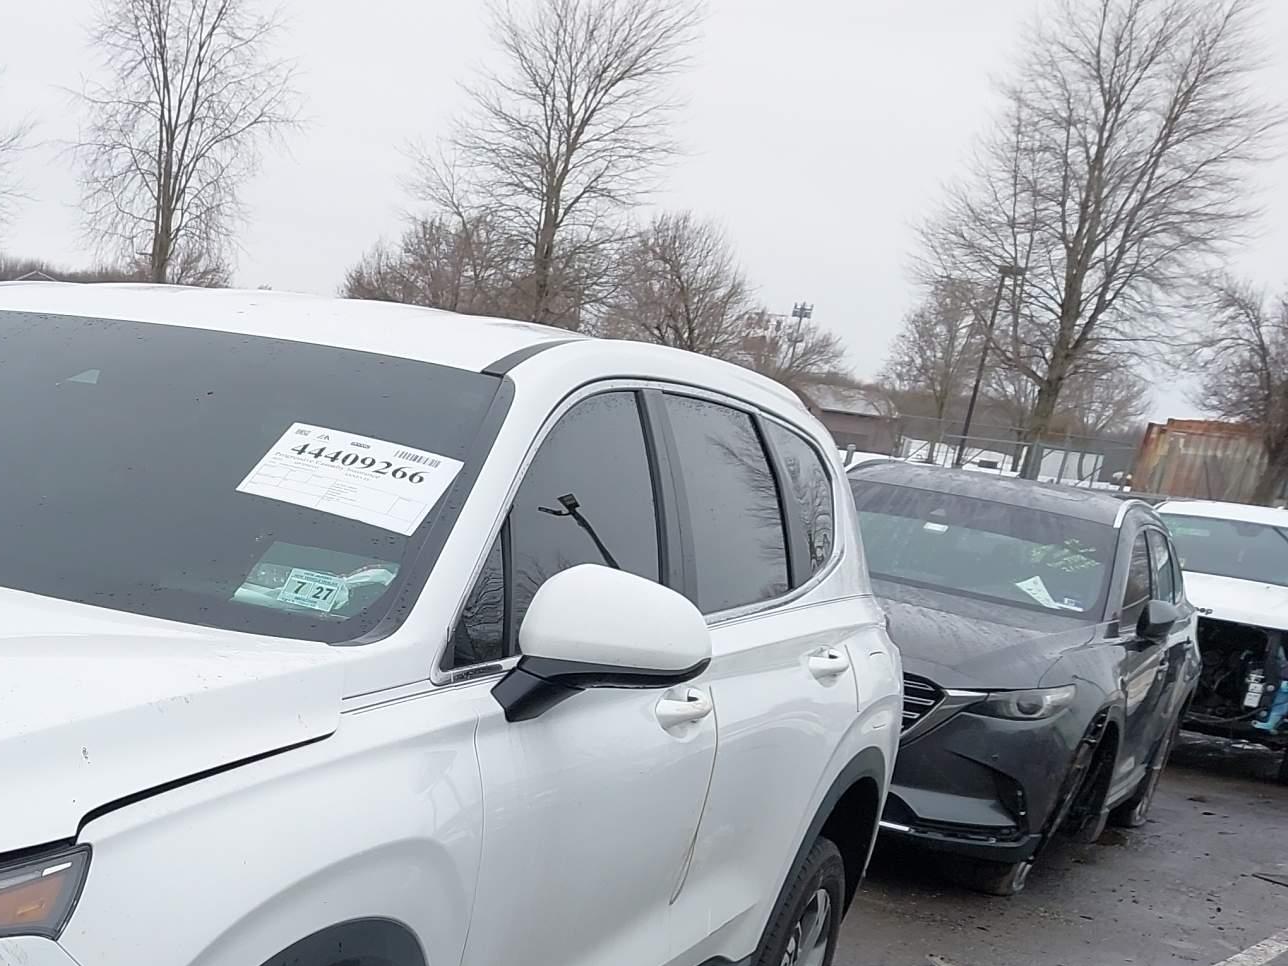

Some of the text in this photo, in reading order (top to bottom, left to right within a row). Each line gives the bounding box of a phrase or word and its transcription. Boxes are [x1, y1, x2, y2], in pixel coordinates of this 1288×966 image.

[291, 443, 430, 484] 44409266
[294, 580, 307, 594] 7
[312, 586, 335, 600] 27
